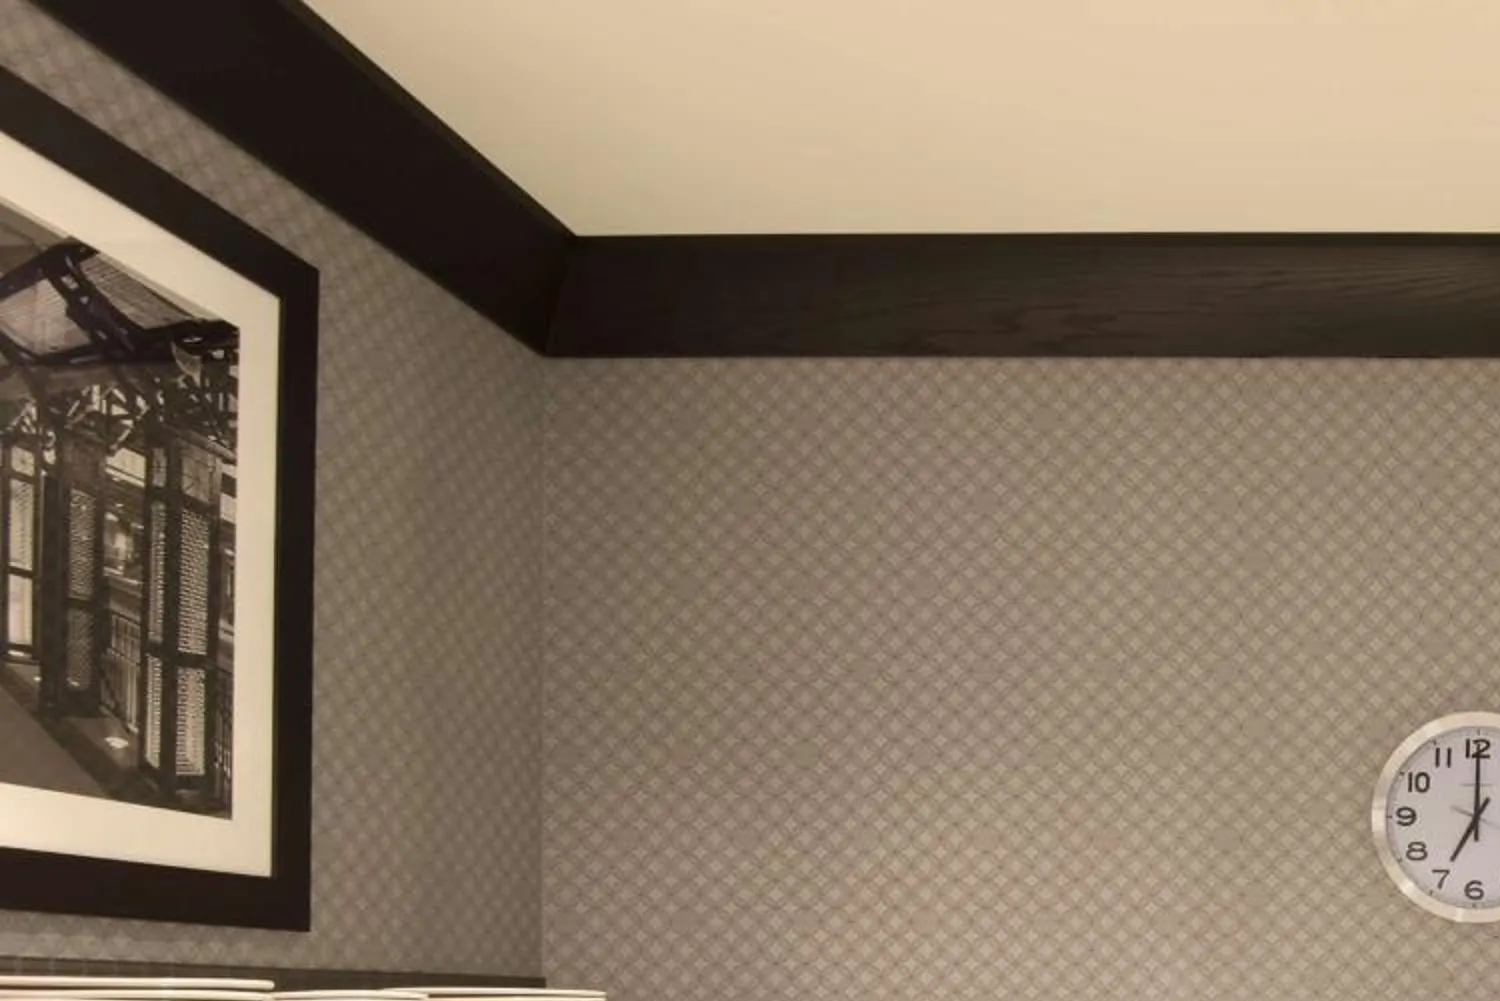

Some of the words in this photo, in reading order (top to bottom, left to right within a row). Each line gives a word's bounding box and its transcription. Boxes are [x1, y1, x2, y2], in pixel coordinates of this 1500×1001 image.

[1435, 748, 1452, 768] 11
[1465, 738, 1491, 759] 12
[1407, 772, 1431, 793] 10
[1396, 806, 1417, 826] 9
[1406, 841, 1428, 861] 8
[1432, 869, 1451, 889] 7
[1464, 880, 1485, 900] 6
